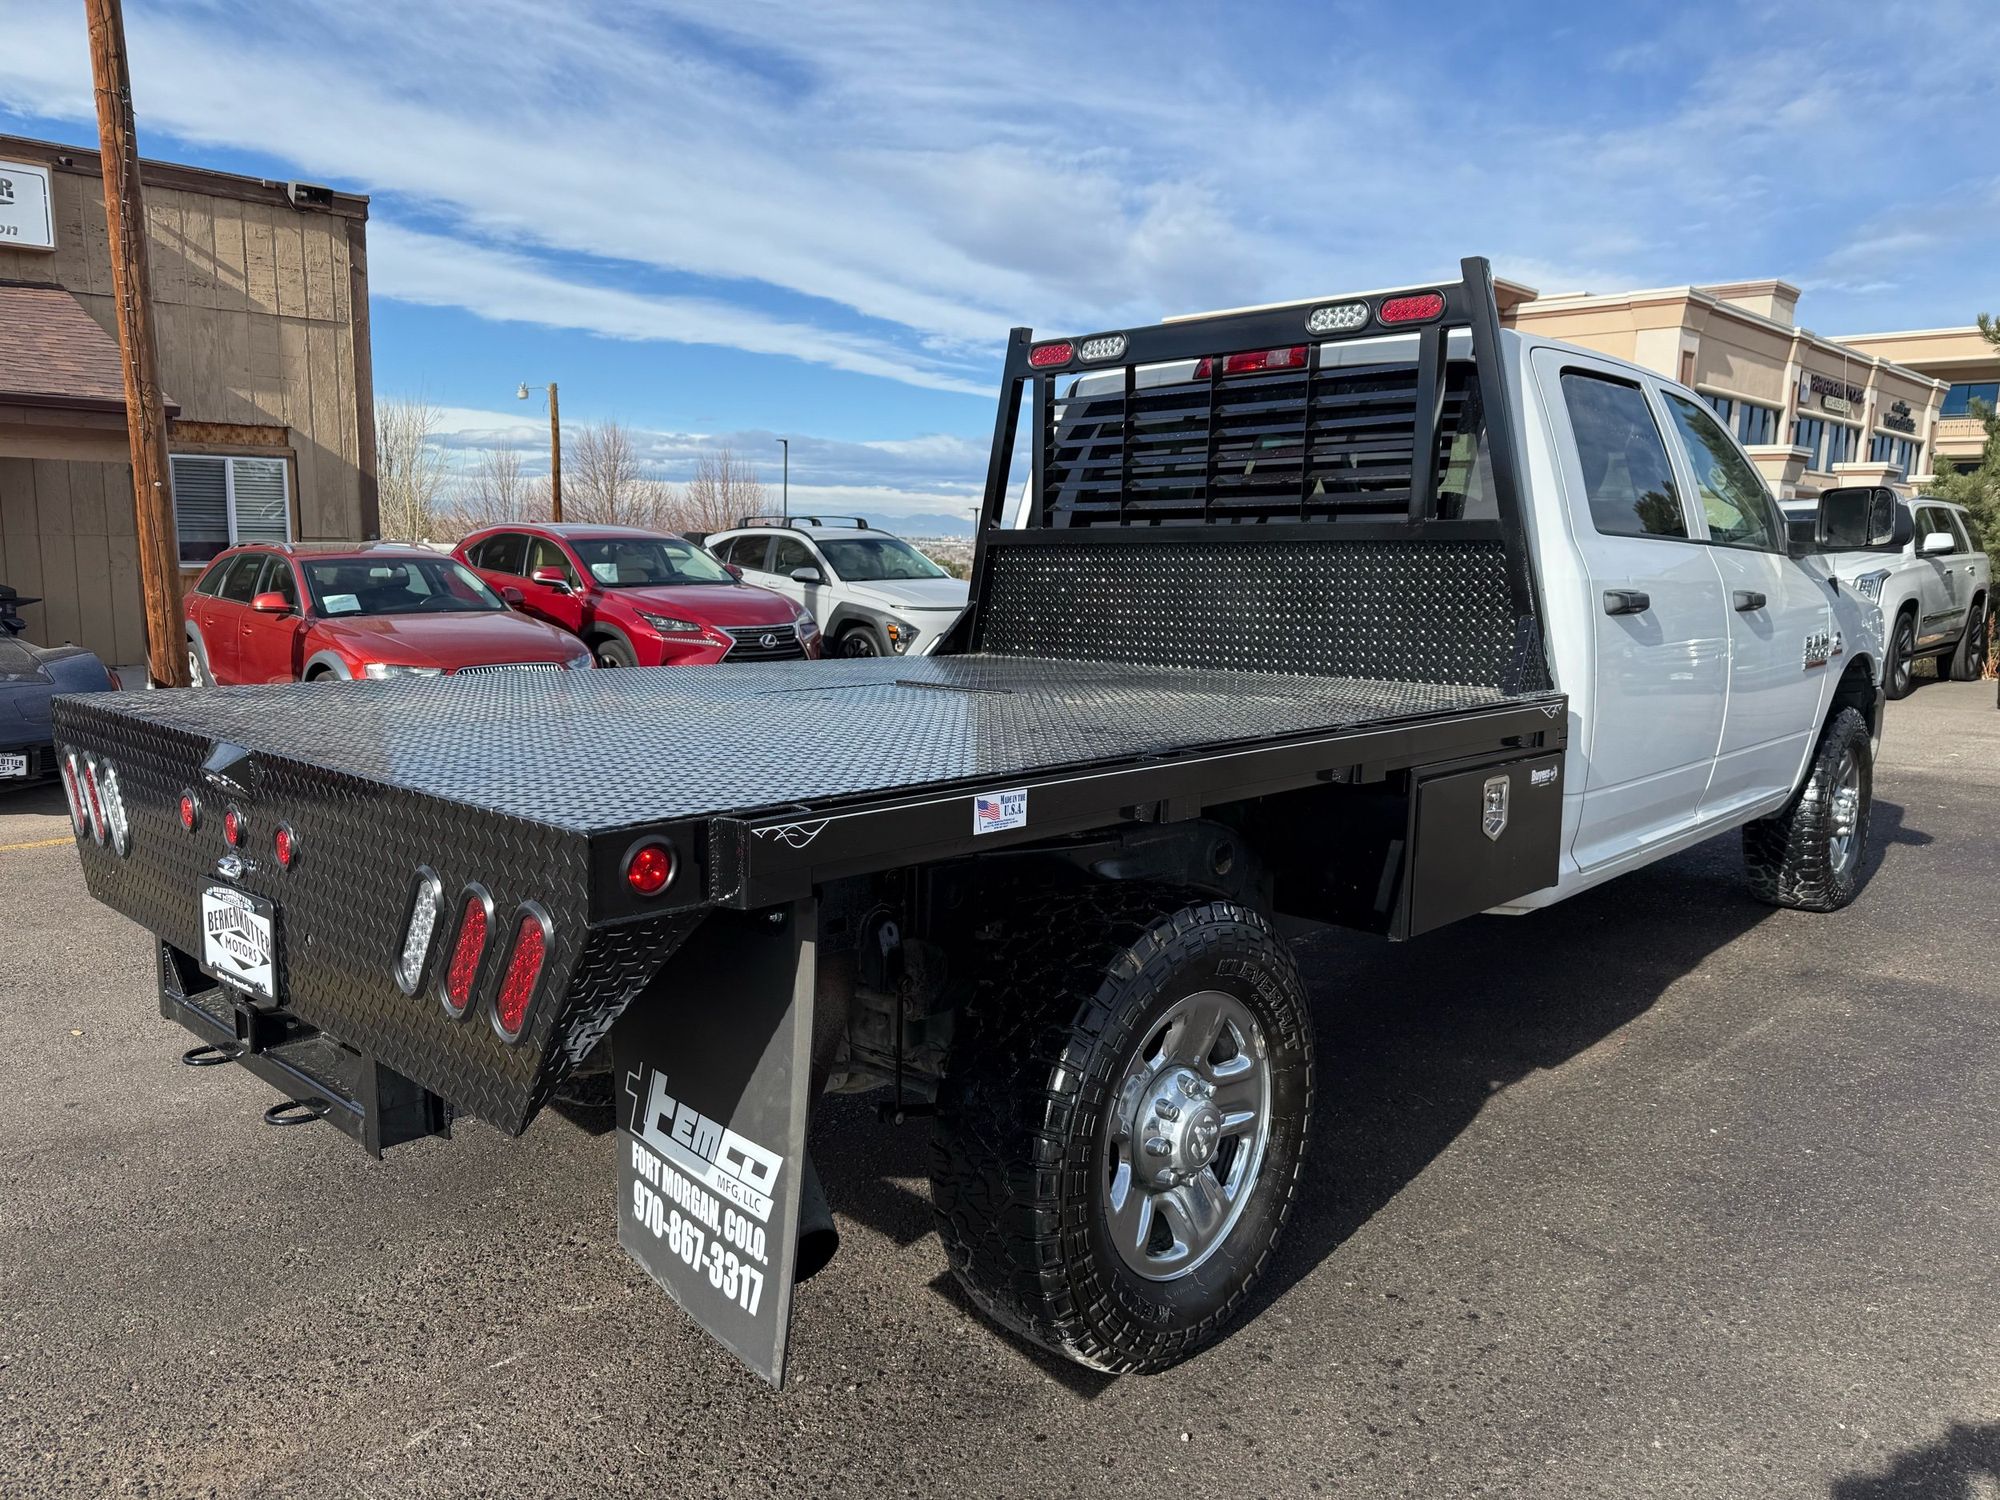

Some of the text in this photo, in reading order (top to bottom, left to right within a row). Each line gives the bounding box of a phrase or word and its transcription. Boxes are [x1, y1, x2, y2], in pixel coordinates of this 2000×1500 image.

[1004, 803, 1024, 816] U.S.A.
[208, 908, 271, 957] BERKENKOTTER
[224, 935, 258, 963] MOTORS
[632, 1140, 769, 1267] FORT MORGAN, COLO.
[743, 1187, 763, 1213] LLC
[633, 1178, 765, 1318] 970-867-3317
